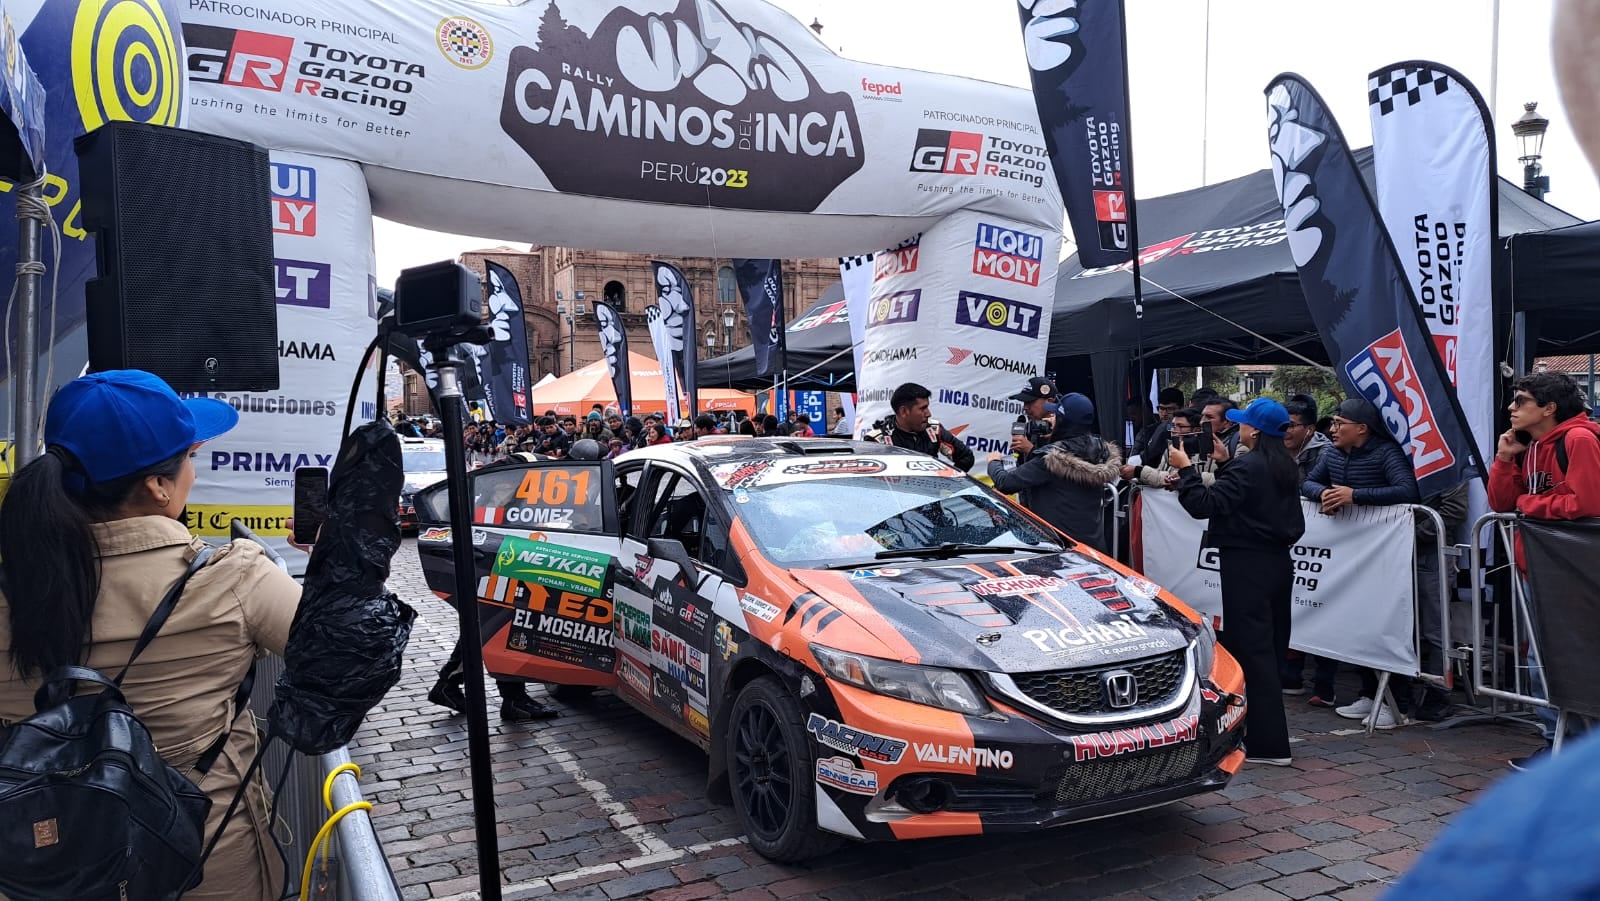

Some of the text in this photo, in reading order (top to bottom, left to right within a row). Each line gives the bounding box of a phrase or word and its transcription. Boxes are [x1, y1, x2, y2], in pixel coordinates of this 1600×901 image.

[189, 0, 400, 44] PATROCINADOR PRINCIPAL
[304, 41, 425, 78] TOYOTA
[299, 61, 413, 94] GAZOO
[562, 62, 614, 87] RALLY
[862, 78, 902, 96] fepad
[294, 78, 407, 116] Racing
[191, 97, 411, 138] ushing the limits for Better
[923, 110, 1039, 135] PATROCINADOR PRINCIPAL
[739, 112, 752, 150] DEL
[754, 110, 855, 157] INCA
[913, 146, 979, 174] GR
[986, 151, 1047, 171] GAZOO
[1086, 117, 1103, 187] TOYOTA
[1099, 122, 1114, 186] GAZOO
[1110, 122, 1122, 186] Racing
[984, 164, 1044, 188] Racing
[917, 184, 954, 195] Pushing
[960, 185, 974, 194] the
[979, 186, 1004, 198] limits
[1007, 190, 1019, 199] for
[272, 201, 314, 232] LY
[1108, 193, 1129, 249] GR
[1200, 220, 1284, 238] TOYO
[979, 225, 1041, 259] LIQUI
[877, 248, 918, 278] MOLY
[976, 251, 1040, 284] MOLY
[1414, 214, 1437, 319] TOYOTA
[1435, 222, 1454, 326] GAZOO
[274, 265, 320, 300] LT
[869, 293, 916, 324] VOLT
[966, 297, 1037, 332] VOLT
[277, 340, 336, 361] HAMA
[973, 353, 1037, 376] YOKOHAMA
[866, 387, 894, 401] Solucio
[939, 388, 1025, 415] INCA Solucion
[1374, 346, 1446, 470] MOLY
[966, 436, 1015, 456] PRIM
[906, 460, 944, 471] 461
[515, 469, 590, 505] 461
[506, 506, 574, 524] GOMEZ
[516, 550, 605, 579] NEYKAR
[1199, 547, 1220, 570] G
[537, 576, 566, 587] PICHARI
[570, 583, 594, 593] VRAEM
[968, 577, 1067, 595] VISCHONGO
[1294, 597, 1324, 608] Better
[512, 608, 533, 629] EL
[688, 670, 704, 690] VOLT
[808, 714, 906, 762] RACING
[1071, 715, 1200, 761] HUAYLLAY
[913, 742, 1015, 769] VALENTINO
[819, 767, 877, 788] DENNIS CAR
